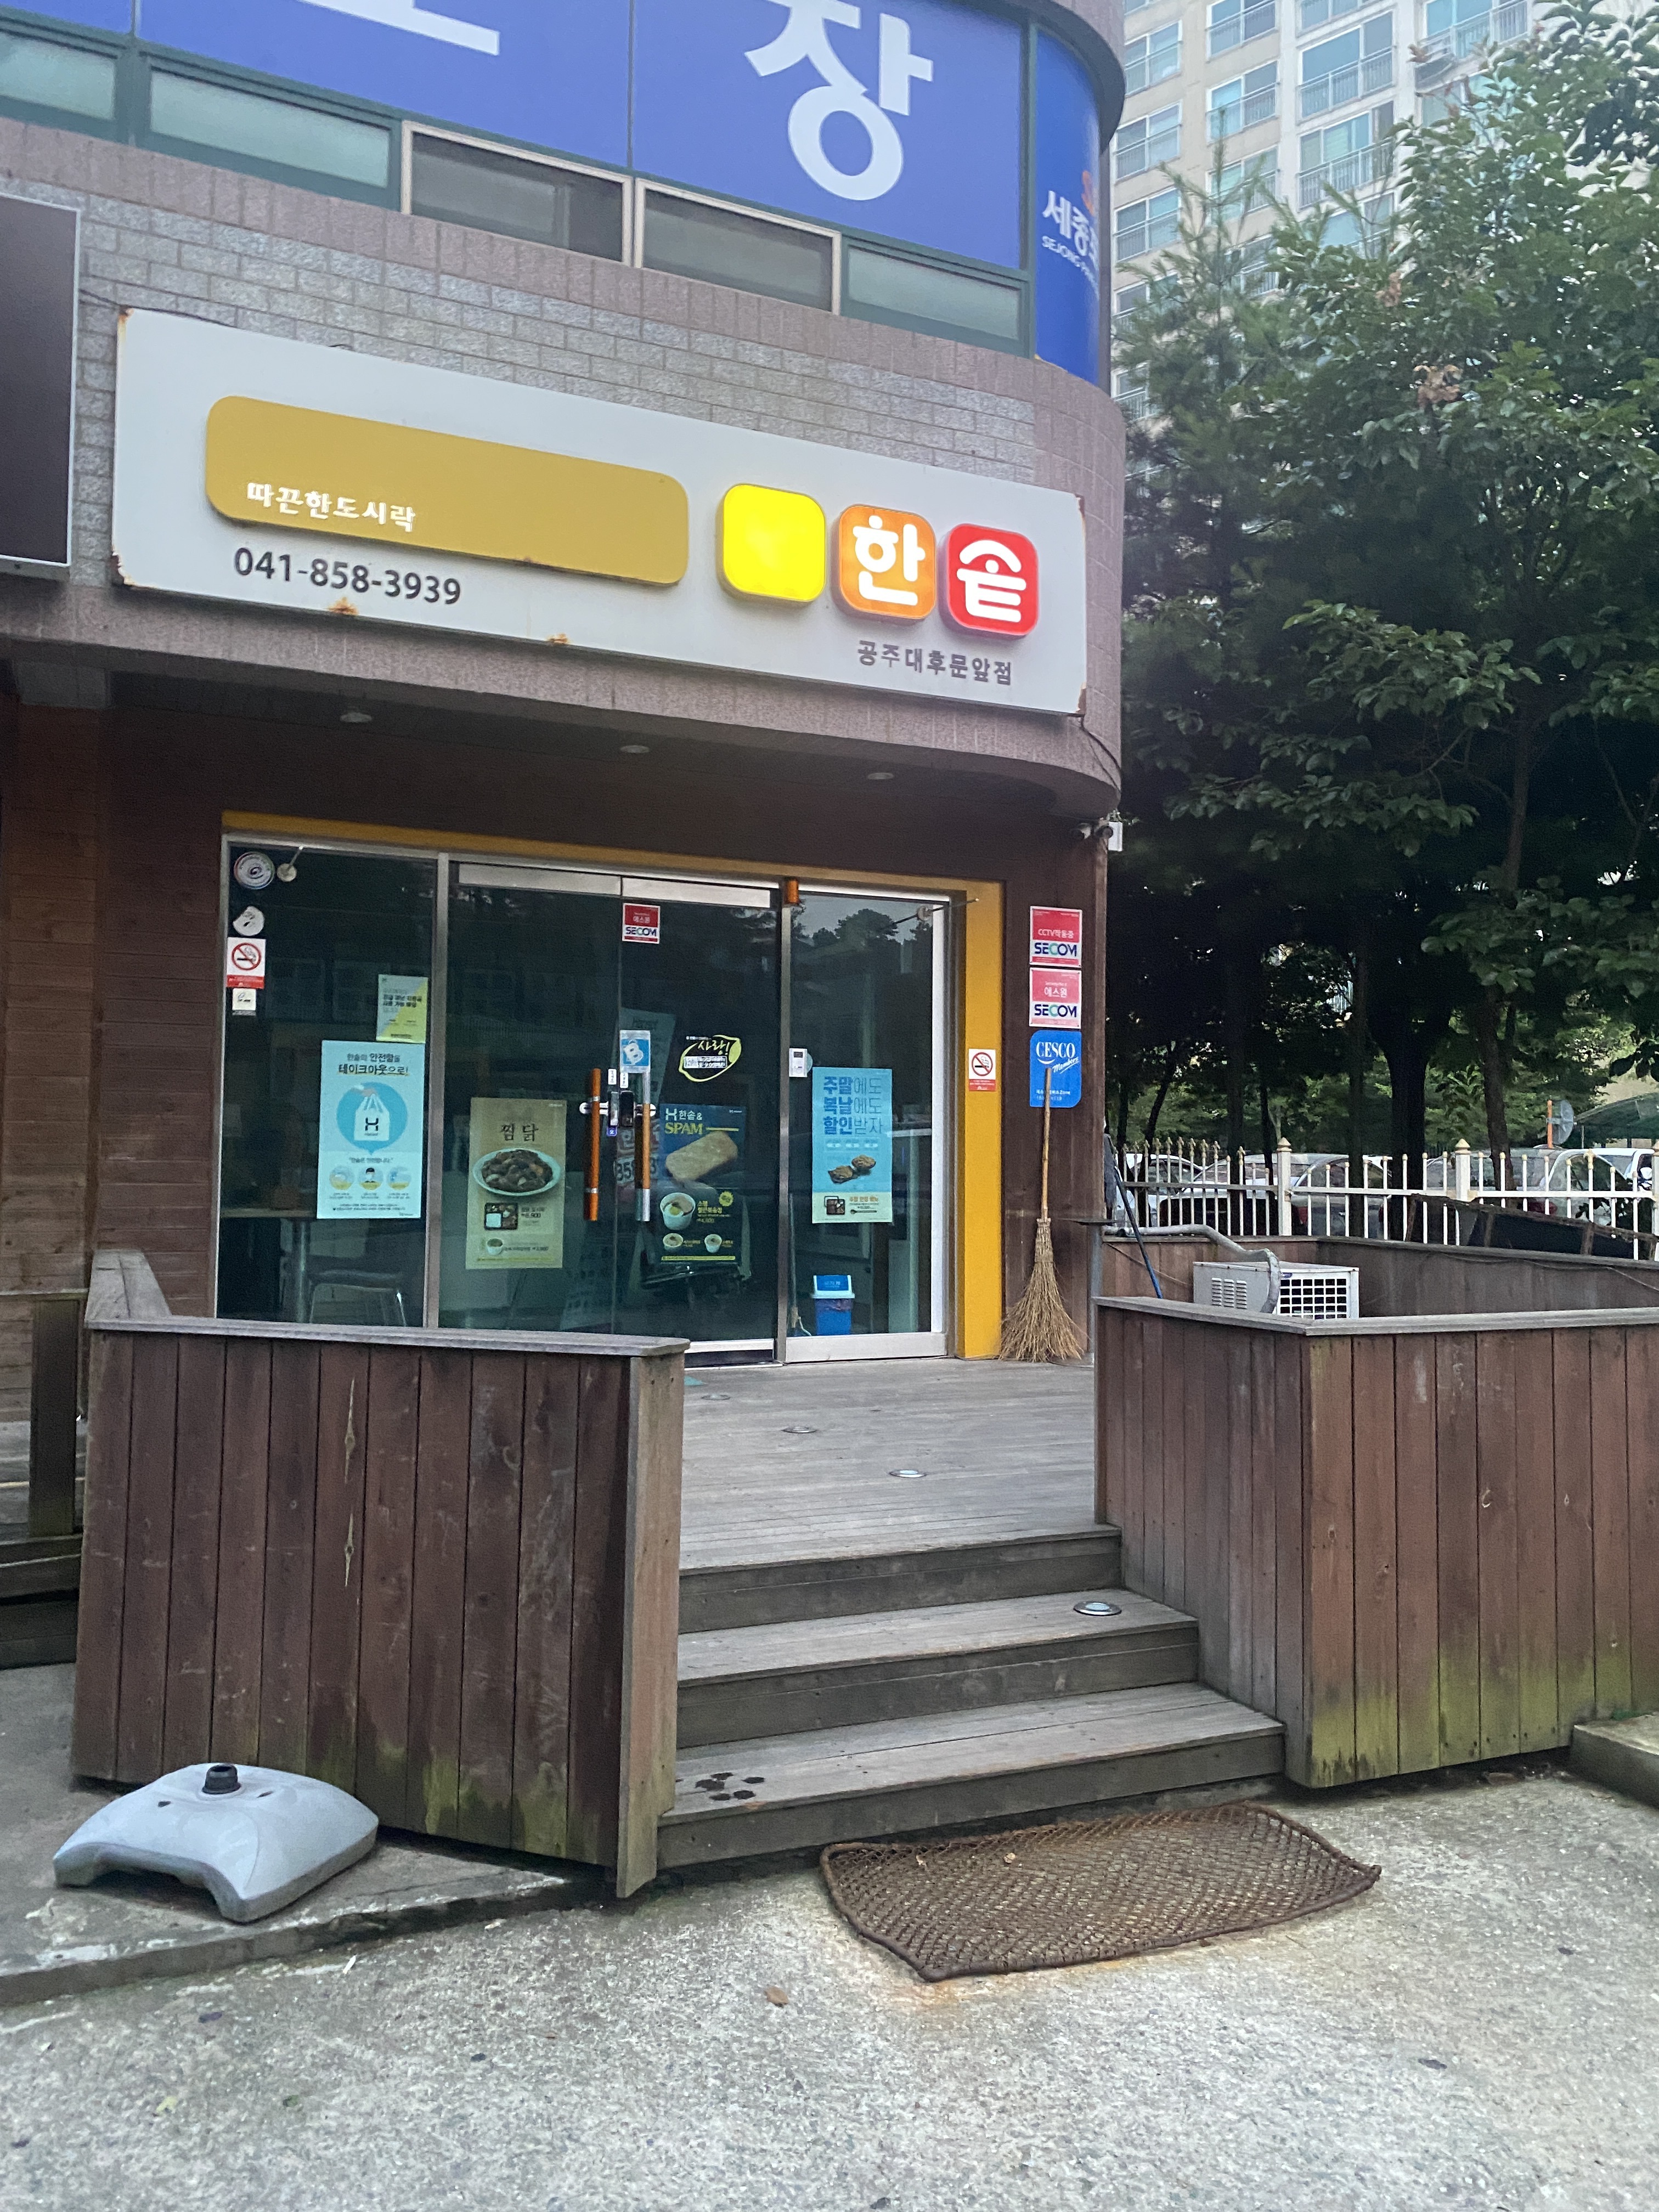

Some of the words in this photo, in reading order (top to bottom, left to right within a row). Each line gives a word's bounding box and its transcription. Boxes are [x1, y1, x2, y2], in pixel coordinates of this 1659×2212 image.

[247, 482, 415, 532] 따끈한도시락
[233, 547, 461, 605] 041-858-3939
[853, 515, 1027, 623] 한솥
[857, 640, 1012, 686] 공주대후문앞점
[625, 926, 657, 937] SECOM
[1034, 942, 1077, 957] SECOM
[1044, 986, 1067, 998] 에스원
[1034, 1004, 1077, 1018] SECOM
[1036, 1041, 1076, 1059] CESCO
[338, 1063, 409, 1076] 테이크아웃으로!
[1052, 1056, 1079, 1073] Members
[823, 1076, 882, 1095] 주말에도
[665, 1122, 703, 1135] SPAM
[823, 1116, 884, 1135] 할인받자
